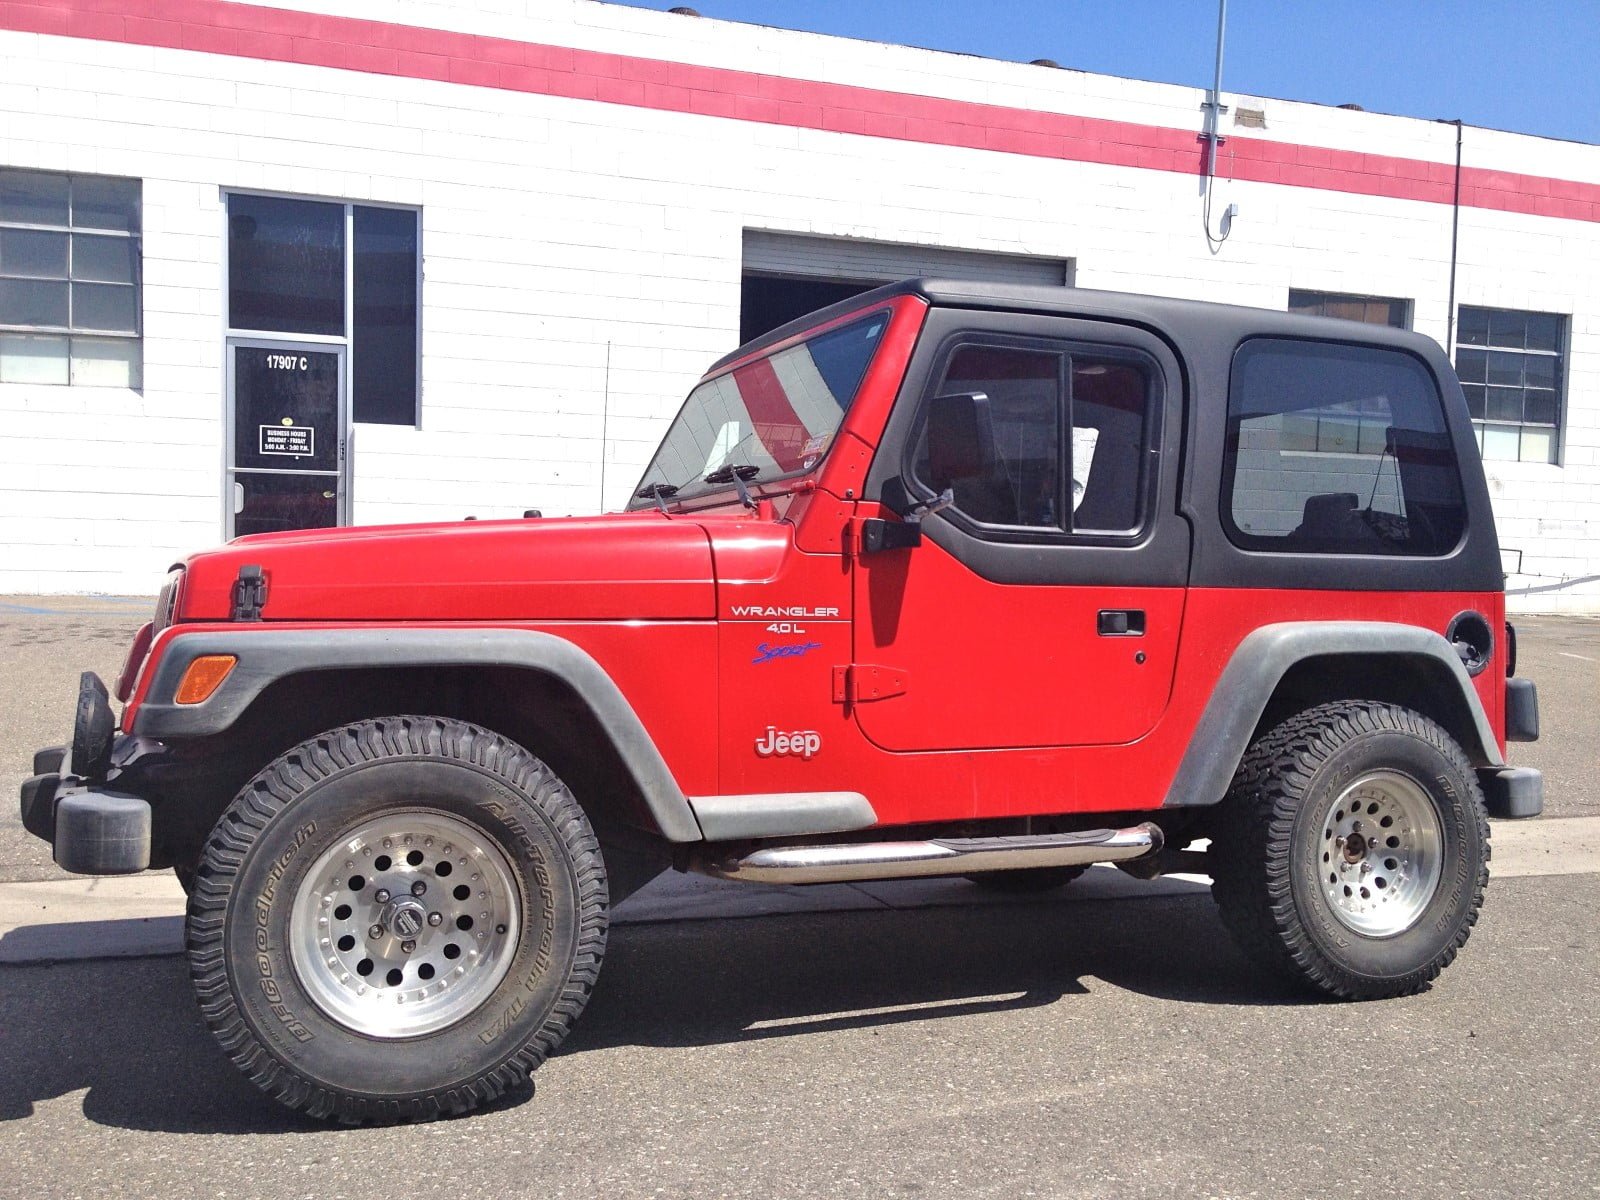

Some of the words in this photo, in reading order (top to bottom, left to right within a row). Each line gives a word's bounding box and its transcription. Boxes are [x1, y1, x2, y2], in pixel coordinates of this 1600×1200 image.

[266, 354, 298, 370] 17907
[300, 356, 308, 371] C
[731, 606, 839, 617] WRANGLER
[755, 725, 822, 760] Jeep
[475, 801, 554, 992] All-Terrain
[256, 819, 318, 1043] BFGoodrich
